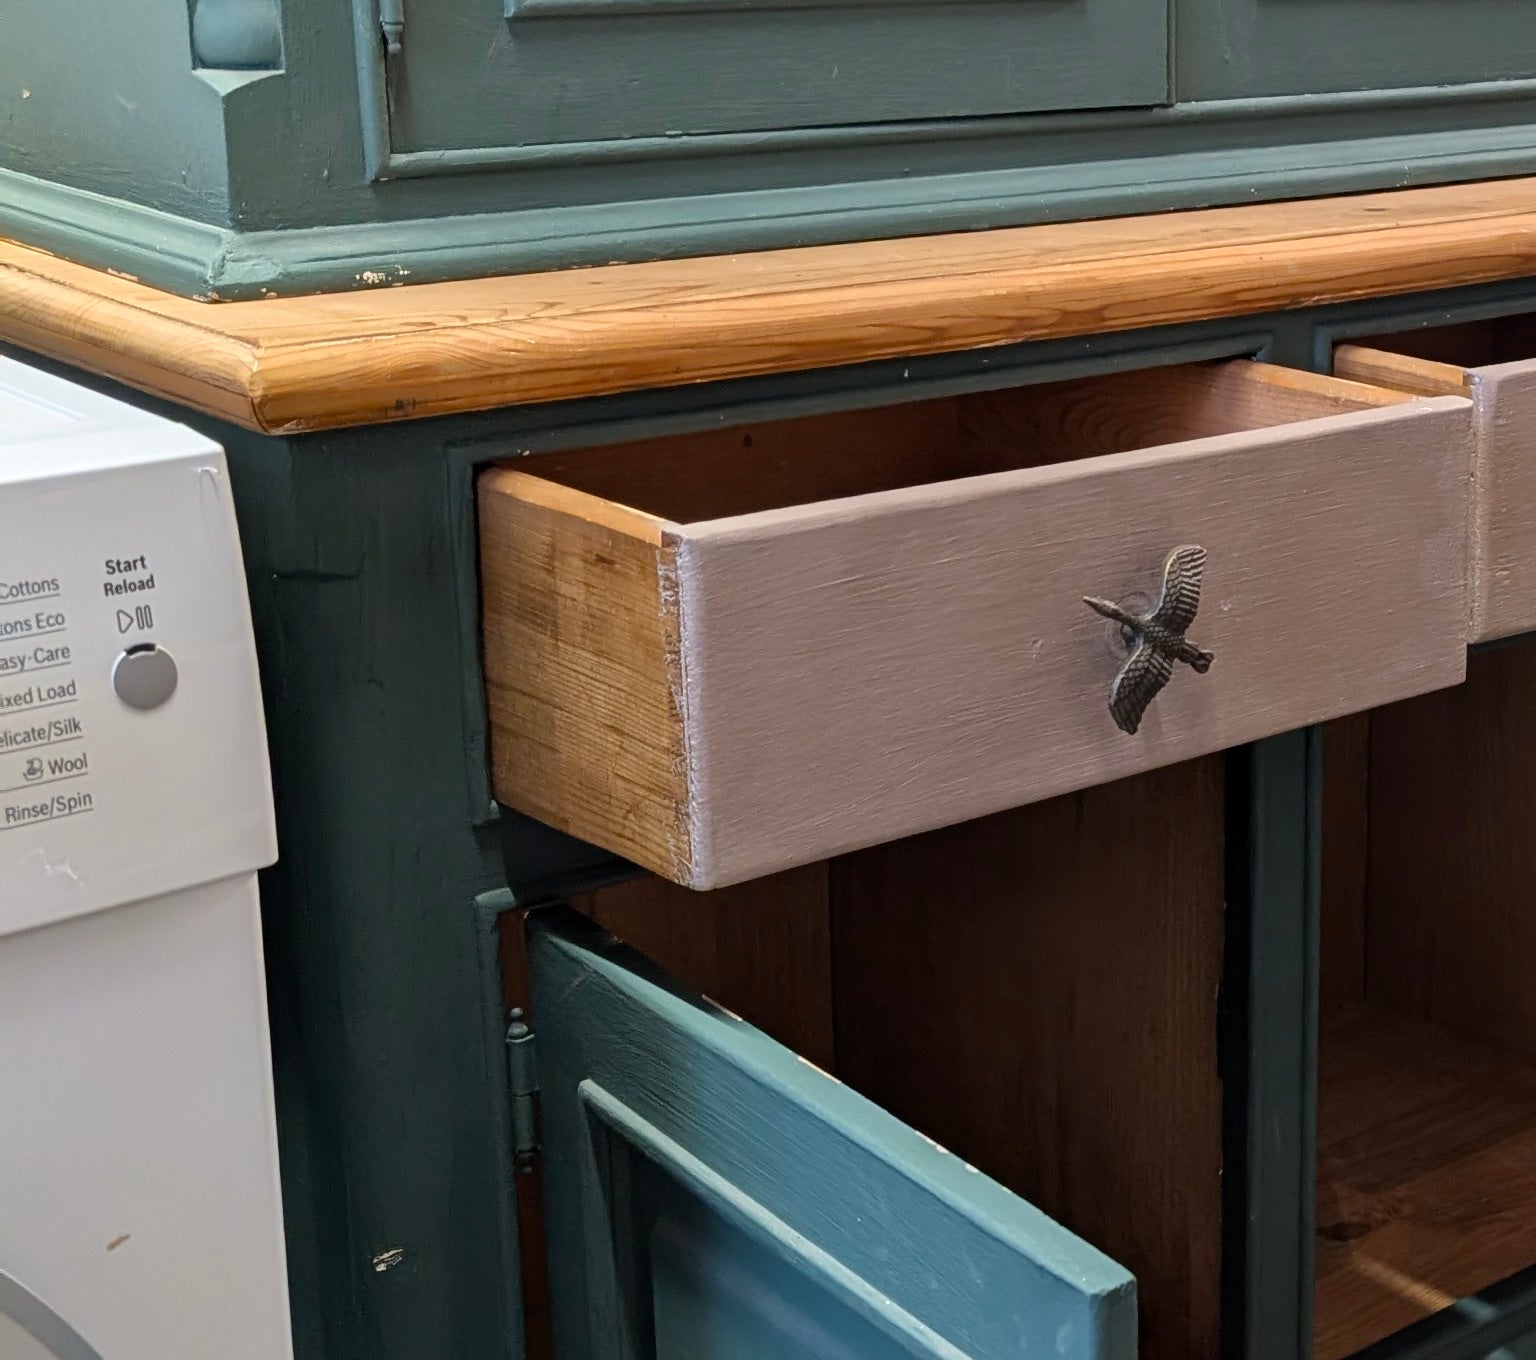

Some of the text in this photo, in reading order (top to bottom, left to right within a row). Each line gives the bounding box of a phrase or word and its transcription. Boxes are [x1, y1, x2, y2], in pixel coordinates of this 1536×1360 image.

[105, 555, 147, 575] Start
[103, 574, 156, 597] Reload
[35, 612, 66, 630] Eco
[37, 681, 77, 702] Load
[48, 752, 89, 776] Wool
[5, 792, 93, 824] Rinse/Spin
